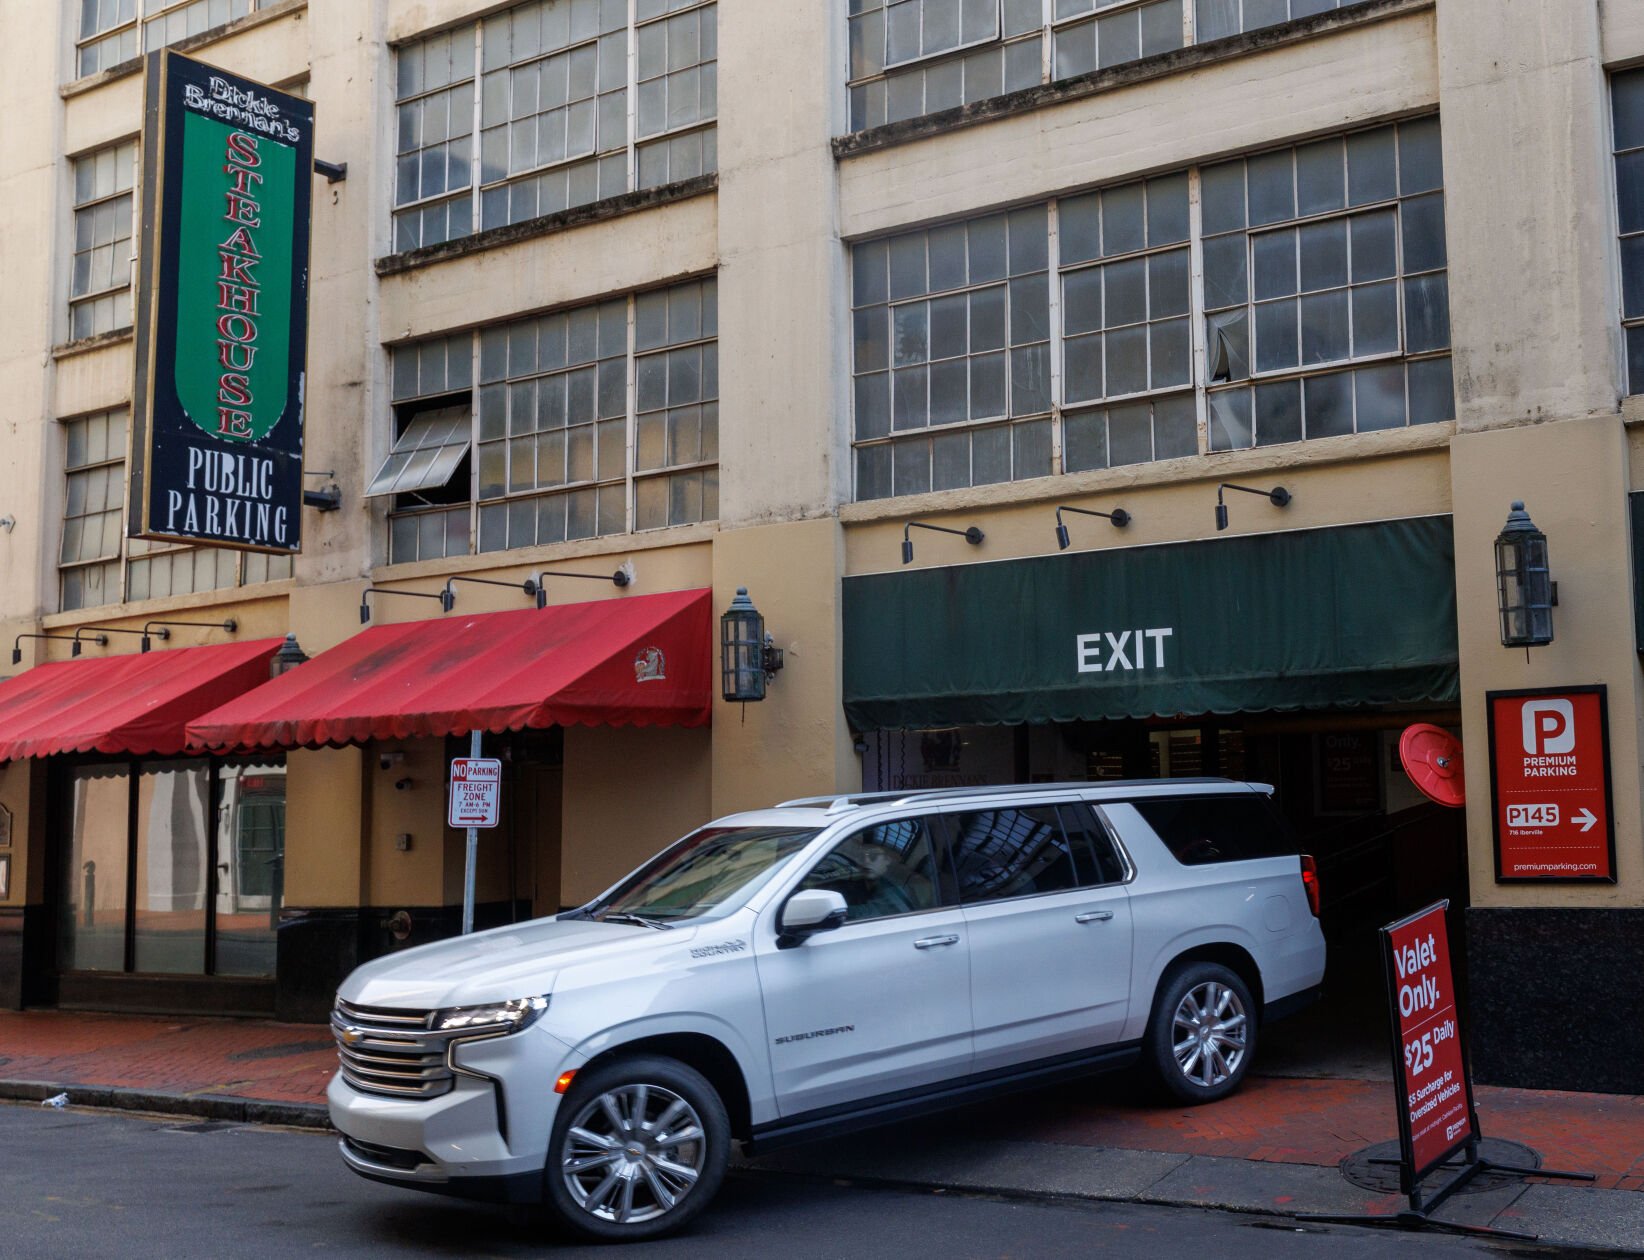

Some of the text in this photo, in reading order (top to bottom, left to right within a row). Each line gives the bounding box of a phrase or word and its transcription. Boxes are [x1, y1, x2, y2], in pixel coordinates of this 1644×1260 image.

[184, 84, 300, 142] Brennan's
[209, 76, 280, 117] Dickie
[216, 131, 263, 438] STEAKHOUSE
[187, 446, 273, 499] PUBLIC
[166, 490, 287, 543] PARKING
[1077, 628, 1173, 672] EXIT
[453, 763, 498, 777] NO PARKING
[1524, 756, 1576, 767] PREMIUM
[1524, 766, 1577, 777] PARKING
[457, 783, 493, 792] FREIGHT
[463, 792, 486, 801] ZONE
[1509, 806, 1557, 824] P145
[1514, 861, 1597, 872] premiumparking.com
[1393, 933, 1436, 979] Valet
[1400, 974, 1440, 1018] Only.
[775, 1024, 856, 1045] SUBURBAN
[1404, 1020, 1454, 1076] $25 Daily
[1408, 1070, 1453, 1107] $5 Surcharge for
[1410, 1082, 1461, 1123] Oversized Vehicles
